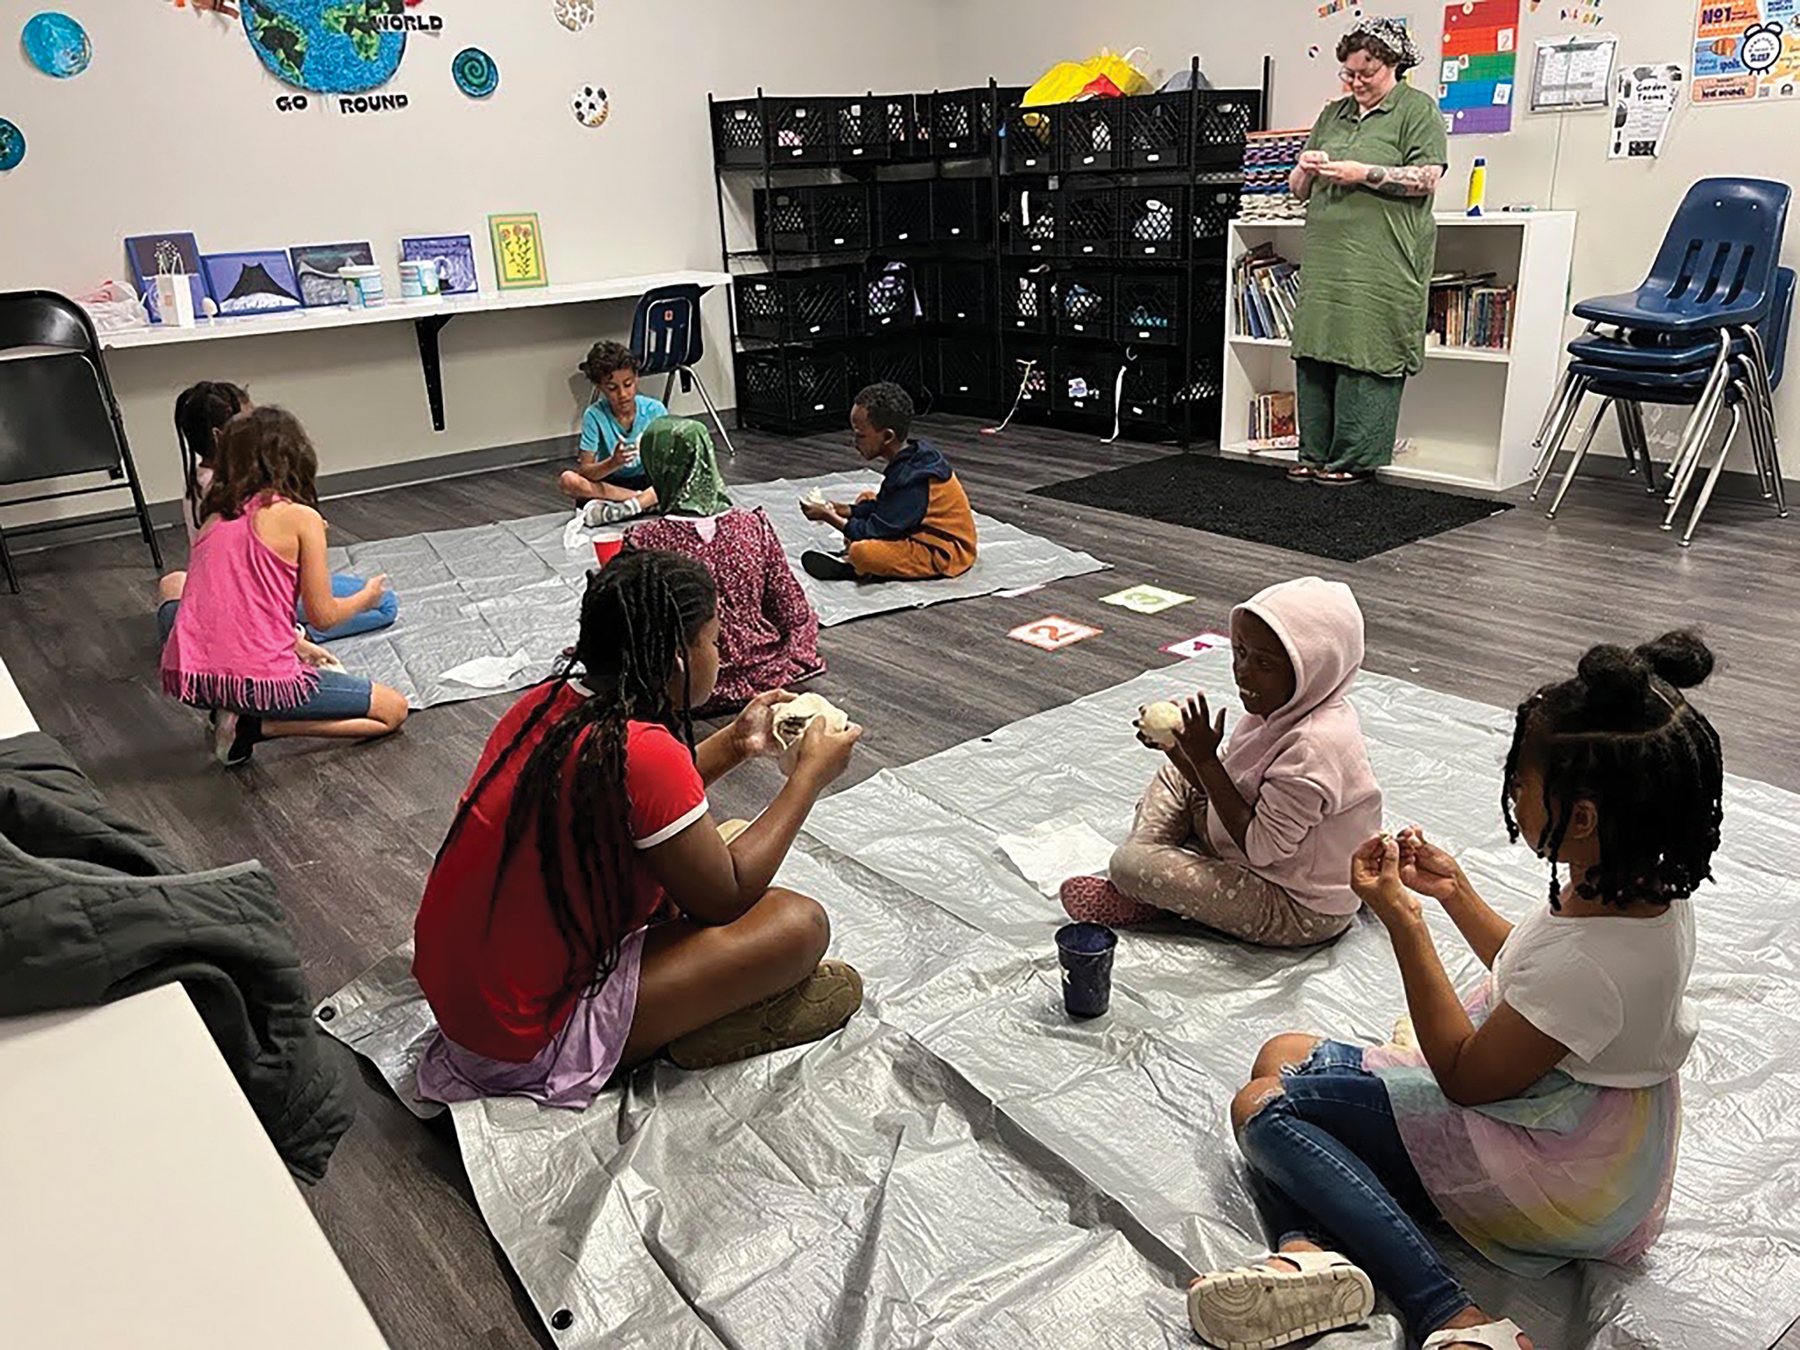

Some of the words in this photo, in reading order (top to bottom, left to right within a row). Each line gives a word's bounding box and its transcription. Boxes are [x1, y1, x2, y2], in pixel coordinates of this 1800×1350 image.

[371, 15, 443, 31] WORLD
[1445, 65, 1456, 79] 3
[1636, 83, 1667, 92] Garden
[276, 96, 307, 111] GO
[340, 95, 409, 113] ROUND
[1029, 624, 1075, 642] 2
